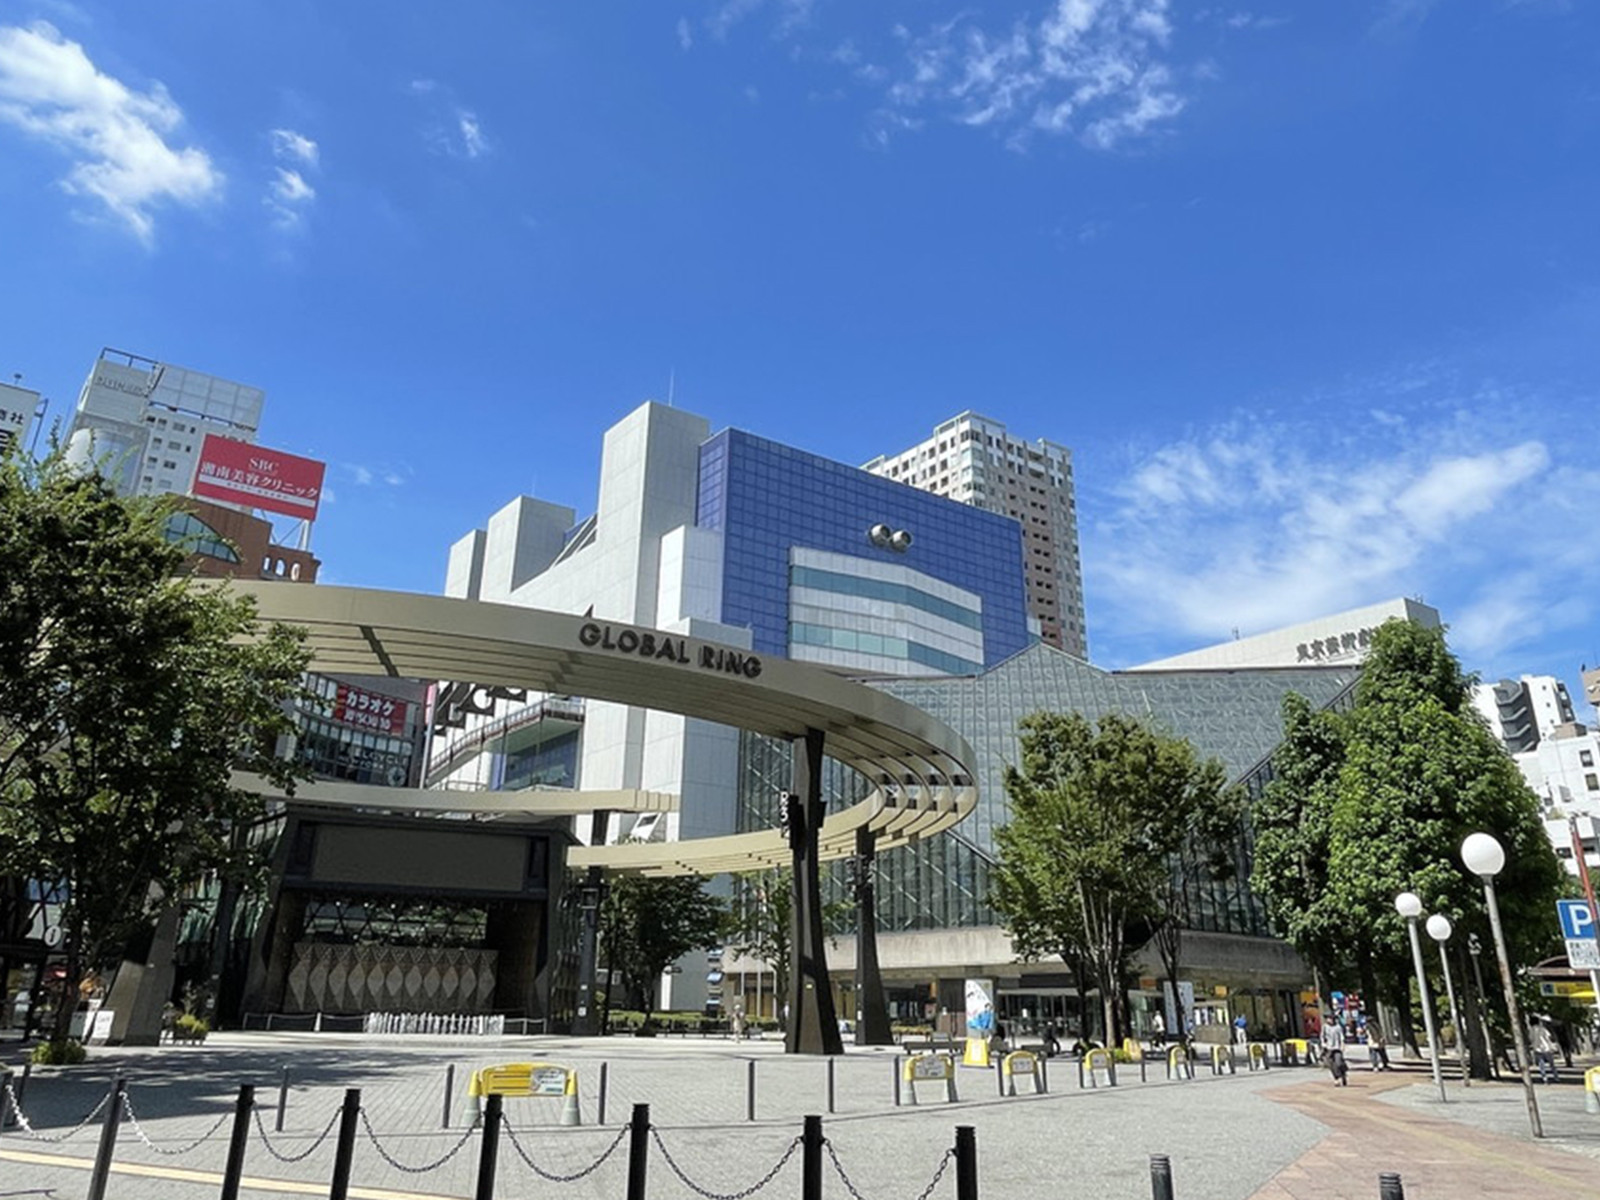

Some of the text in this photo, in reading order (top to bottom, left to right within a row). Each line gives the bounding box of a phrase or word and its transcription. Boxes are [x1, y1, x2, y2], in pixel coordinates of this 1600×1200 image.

[248, 457, 279, 473] SBC
[579, 622, 762, 678] GLOBAL RING
[346, 690, 395, 716] カラオケ
[1568, 904, 1593, 935] P
